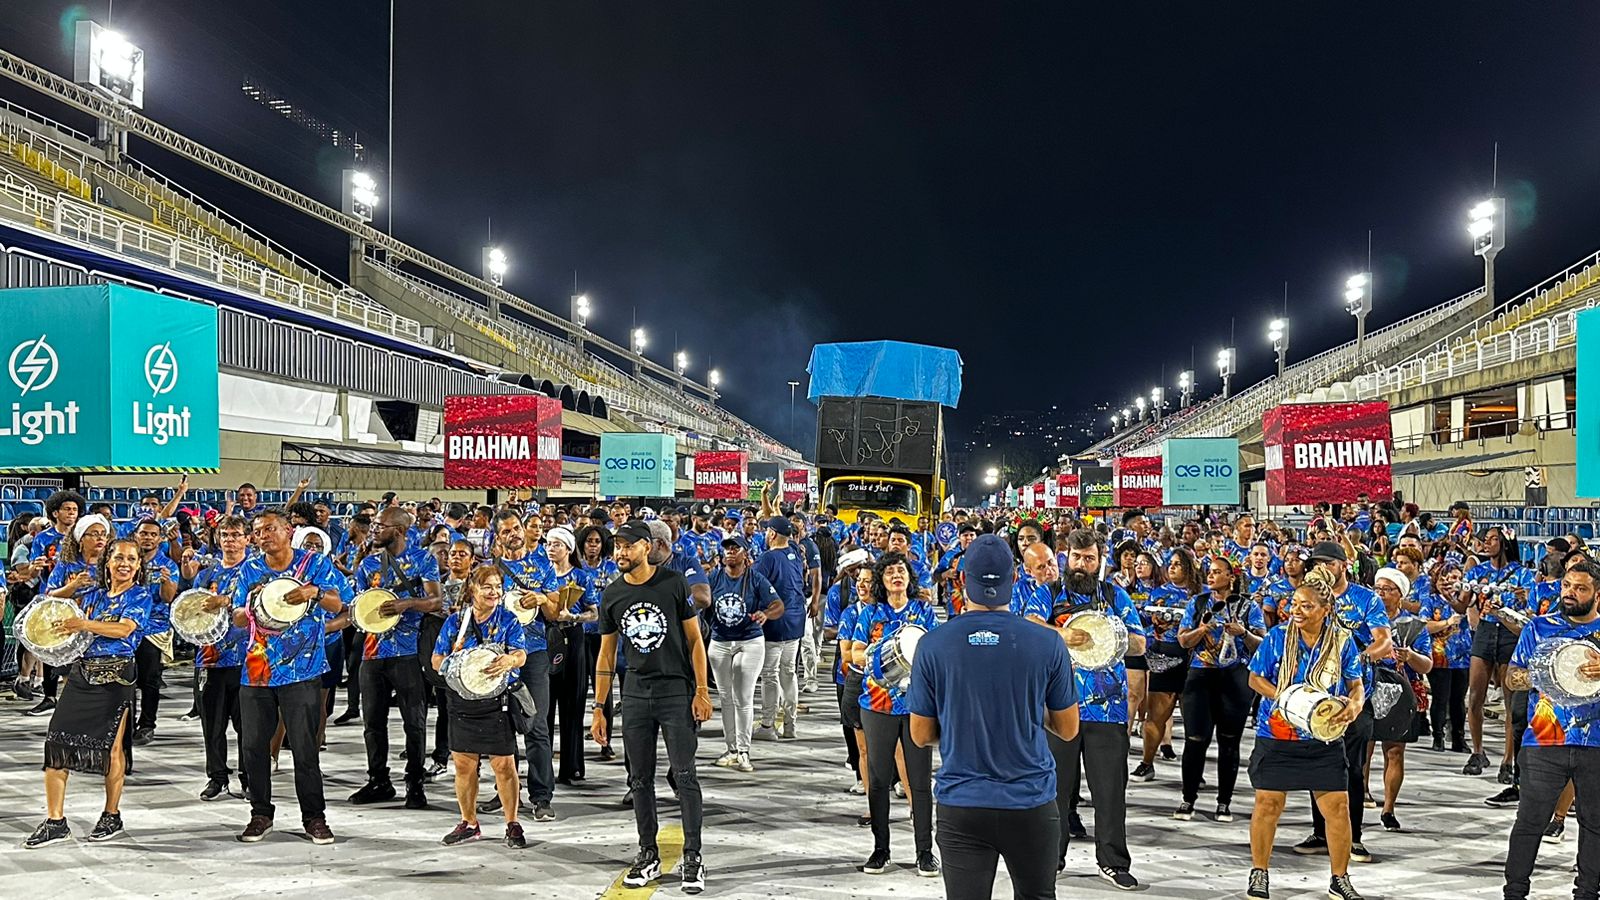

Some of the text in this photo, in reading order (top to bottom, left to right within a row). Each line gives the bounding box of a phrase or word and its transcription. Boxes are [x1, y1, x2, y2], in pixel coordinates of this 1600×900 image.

[133, 401, 191, 445] Light
[449, 435, 531, 460] BRAHMA
[1294, 440, 1388, 469] BRAHMA
[631, 458, 656, 470] RIO
[1203, 464, 1232, 477] RIO
[696, 471, 738, 485] BRAHMA
